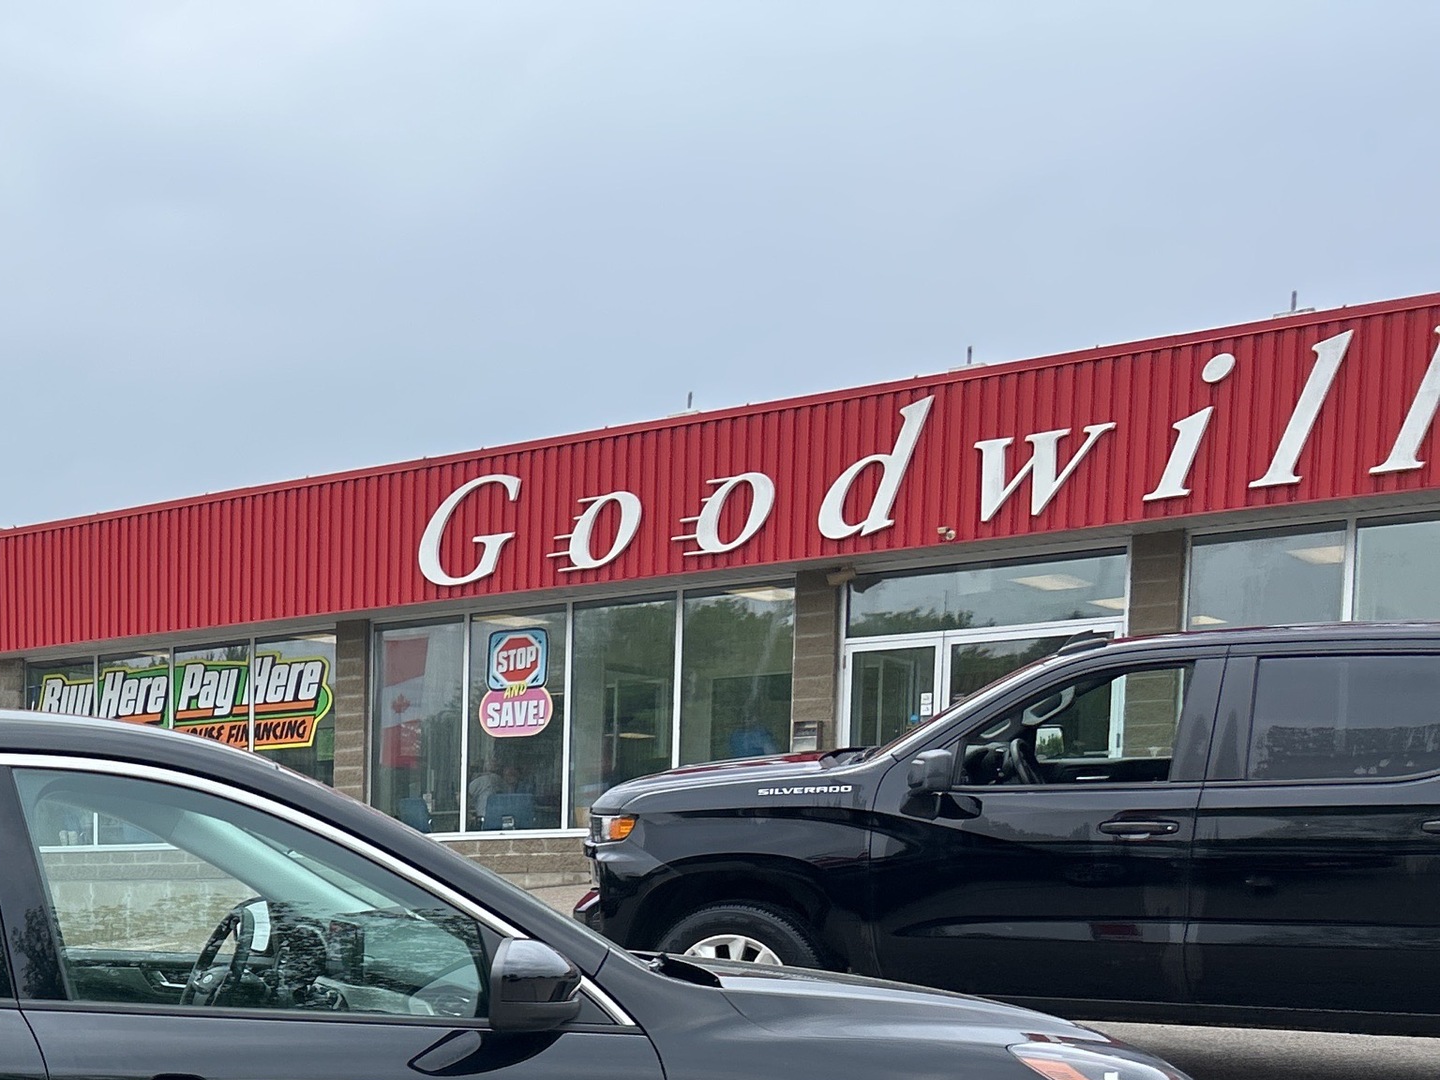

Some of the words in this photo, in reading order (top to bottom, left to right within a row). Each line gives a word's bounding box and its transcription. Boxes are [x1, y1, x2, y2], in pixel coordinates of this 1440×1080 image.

[418, 325, 1440, 586] Goodwill
[497, 646, 536, 673] STOP
[99, 671, 168, 719] Here
[178, 663, 239, 716] Pay
[242, 657, 322, 705] Here
[504, 683, 527, 699] AND
[487, 700, 545, 728] SAVE!
[758, 785, 853, 795] SILVERADO
